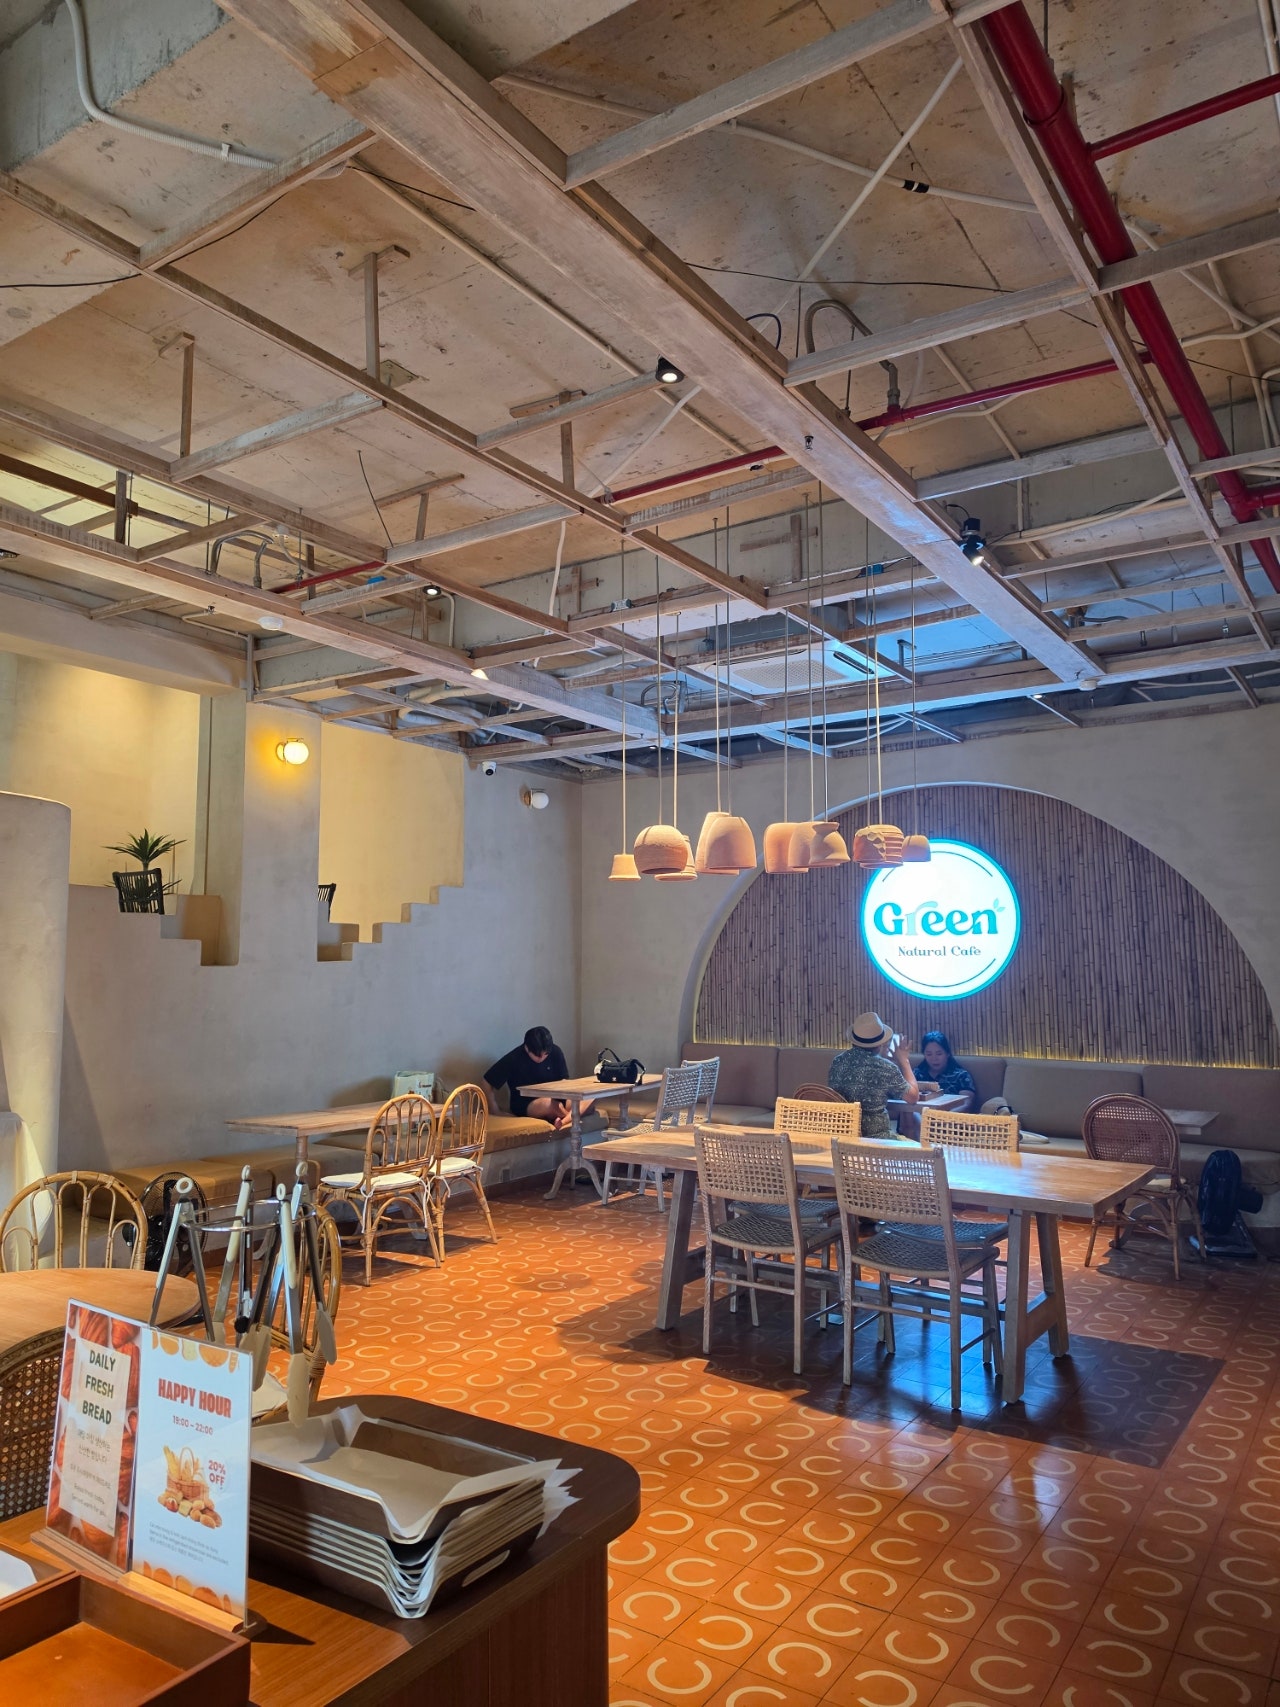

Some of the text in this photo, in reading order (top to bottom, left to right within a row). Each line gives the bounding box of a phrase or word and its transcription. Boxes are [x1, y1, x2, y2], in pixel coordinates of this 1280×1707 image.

[873, 901, 999, 936] Green
[898, 945, 947, 957] Natural
[89, 1350, 116, 1372] DAILY
[85, 1374, 114, 1399] FRESH
[158, 1378, 232, 1418] HAPPY HOUR
[82, 1400, 112, 1425] BREAD
[195, 1422, 213, 1435] 22:00
[208, 1460, 226, 1475] 20%
[209, 1473, 225, 1487] OFF
